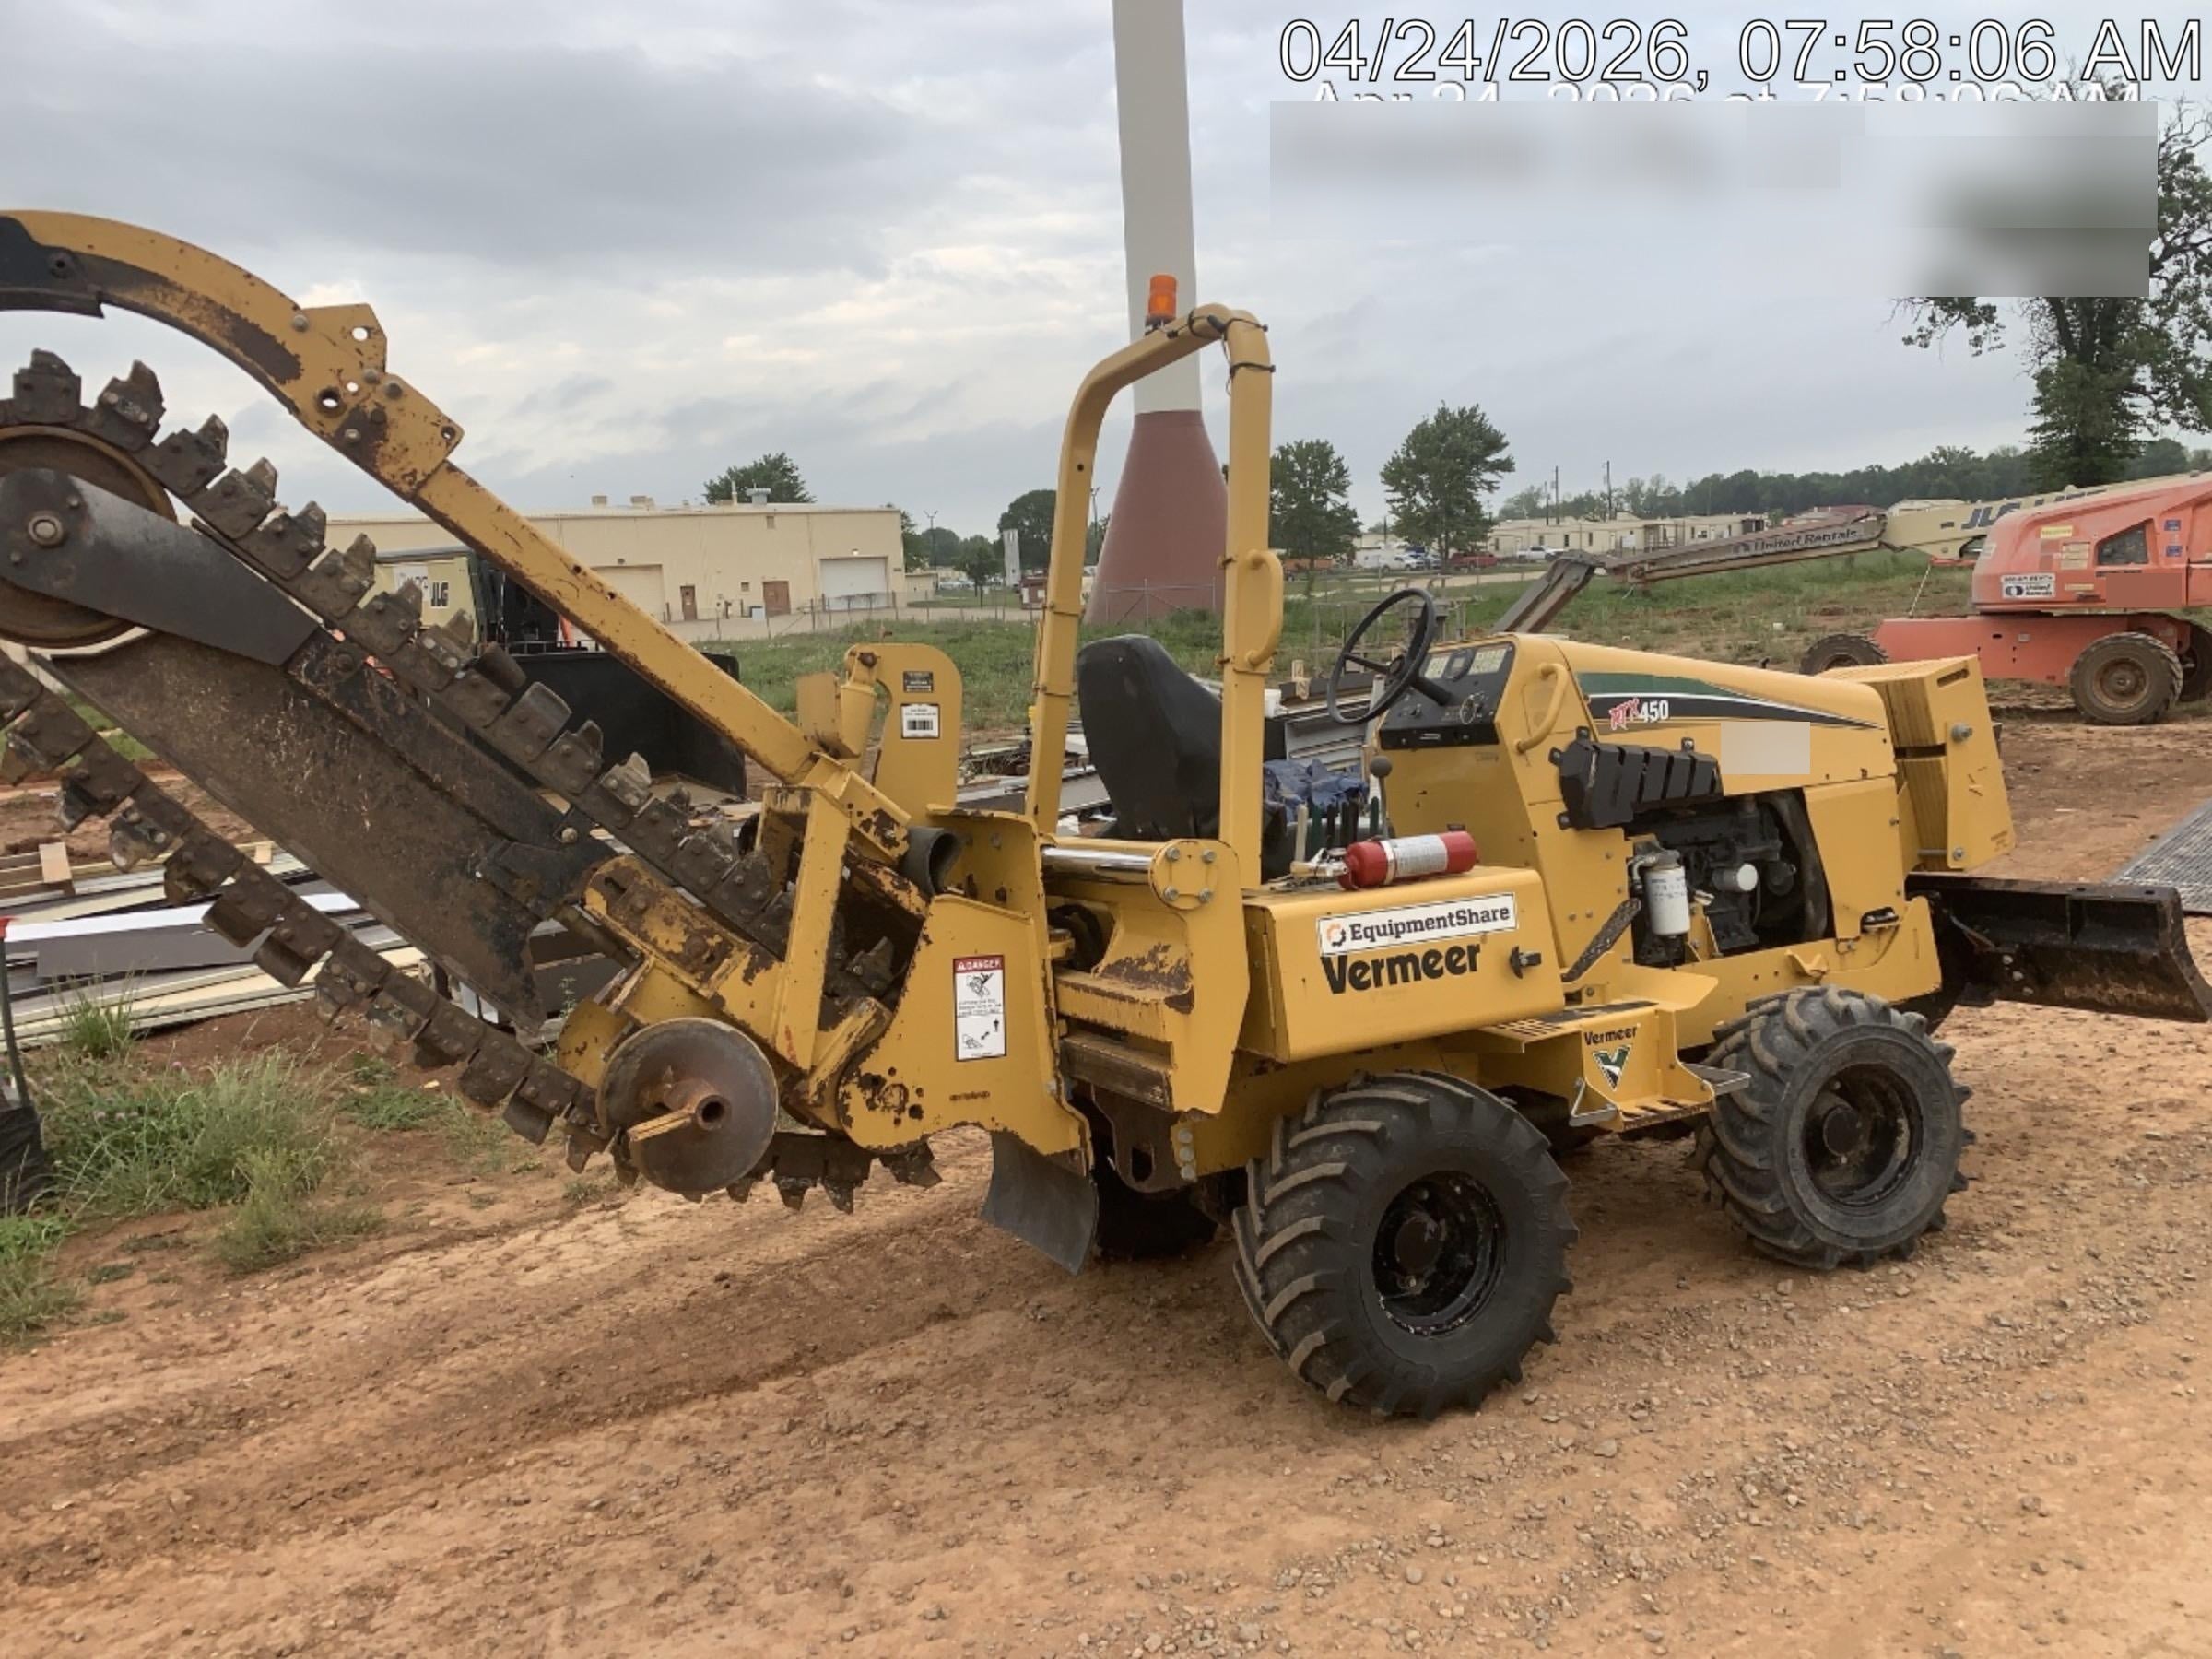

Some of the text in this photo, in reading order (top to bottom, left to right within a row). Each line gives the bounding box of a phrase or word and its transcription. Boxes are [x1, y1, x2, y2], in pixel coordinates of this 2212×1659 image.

[1754, 528, 1858, 553] United Rentals
[430, 582, 449, 606] JLG
[1640, 700, 1669, 723] 450
[1349, 905, 1511, 942] EquipmentShare
[966, 959, 1001, 971] DANGER
[1320, 943, 1481, 994] Vermeer
[1583, 1026, 1638, 1046] Vermeer
